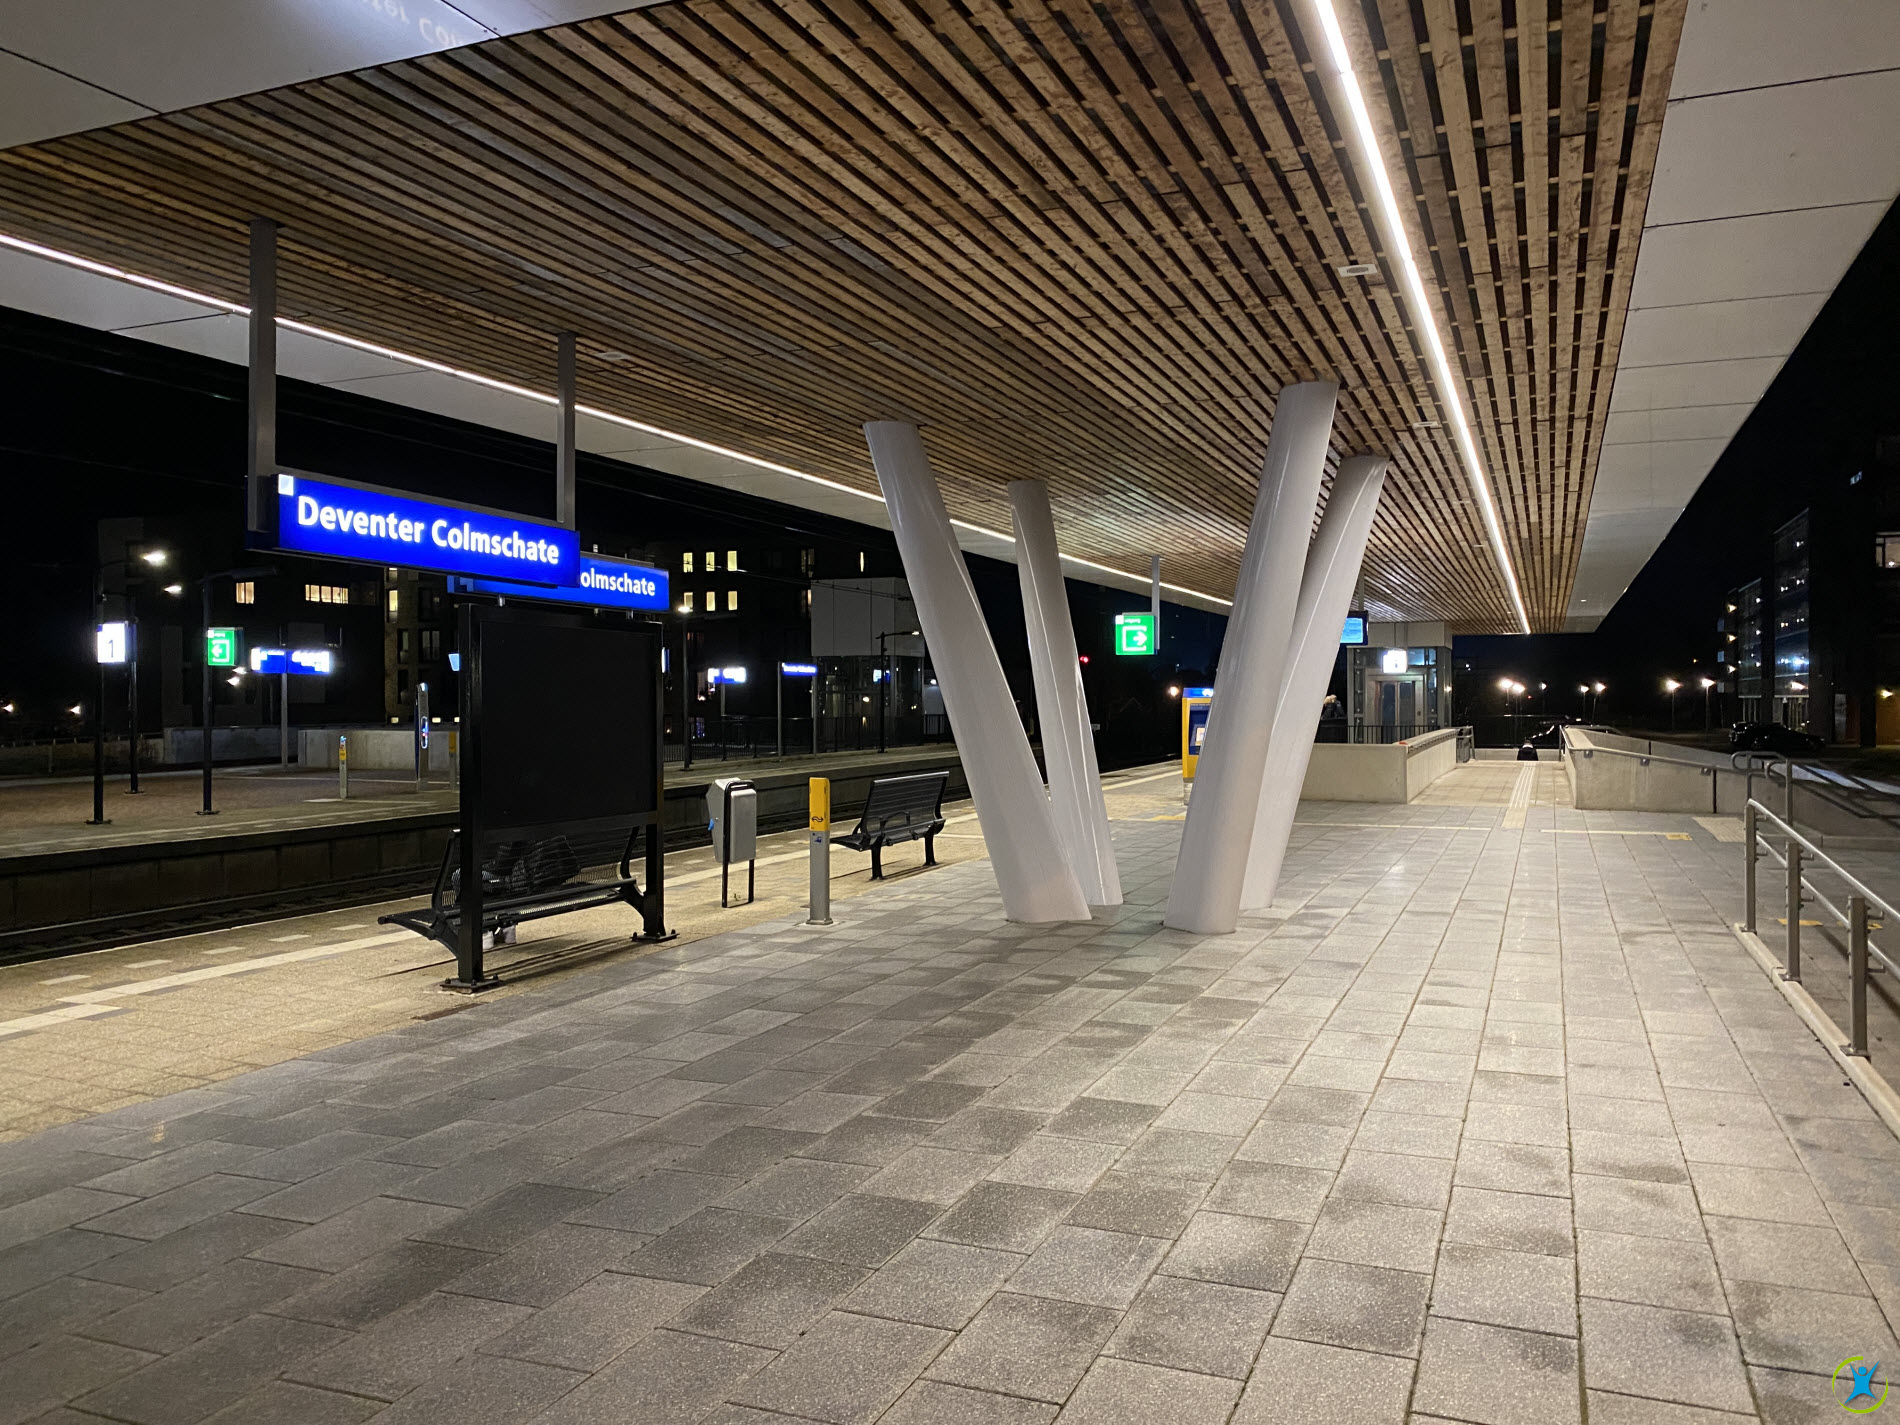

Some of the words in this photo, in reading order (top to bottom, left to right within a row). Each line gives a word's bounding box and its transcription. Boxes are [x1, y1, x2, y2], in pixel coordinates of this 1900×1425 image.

[298, 495, 425, 543] Deventer
[431, 519, 560, 565] Colmschate
[580, 567, 656, 597] olmschate
[108, 639, 114, 658] 1
